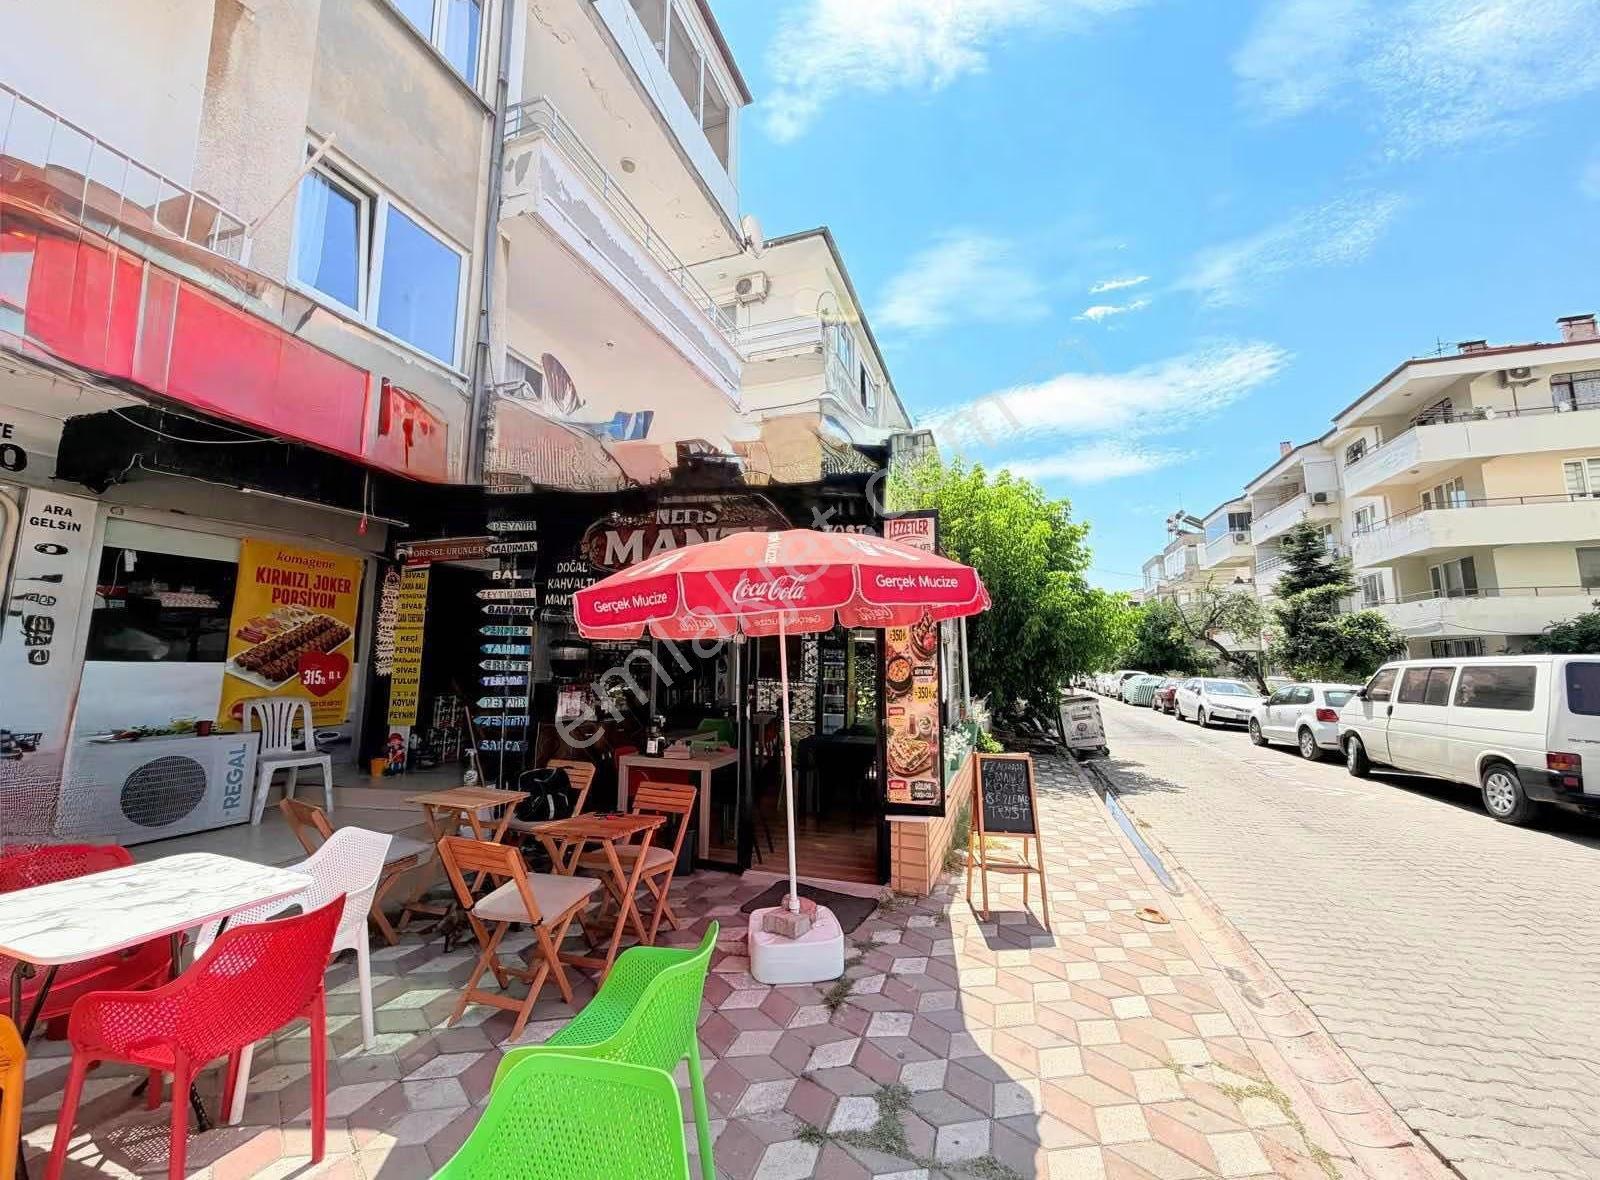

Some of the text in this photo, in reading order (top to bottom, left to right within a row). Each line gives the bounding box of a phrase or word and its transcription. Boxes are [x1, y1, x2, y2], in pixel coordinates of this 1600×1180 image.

[0, 423, 14, 438] E
[44, 504, 73, 517] ARA
[30, 516, 82, 532] GELSİN
[889, 520, 928, 539] LEZZETLER
[557, 560, 588, 573] DOĞAL
[256, 566, 352, 594] KIRMIZI JOKER
[492, 570, 521, 580] BAL
[876, 574, 958, 590] Gerçek Mucize
[272, 586, 337, 609] PORSİYON
[594, 592, 668, 613] Gerçek Mucize
[223, 744, 247, 810] REGAL
